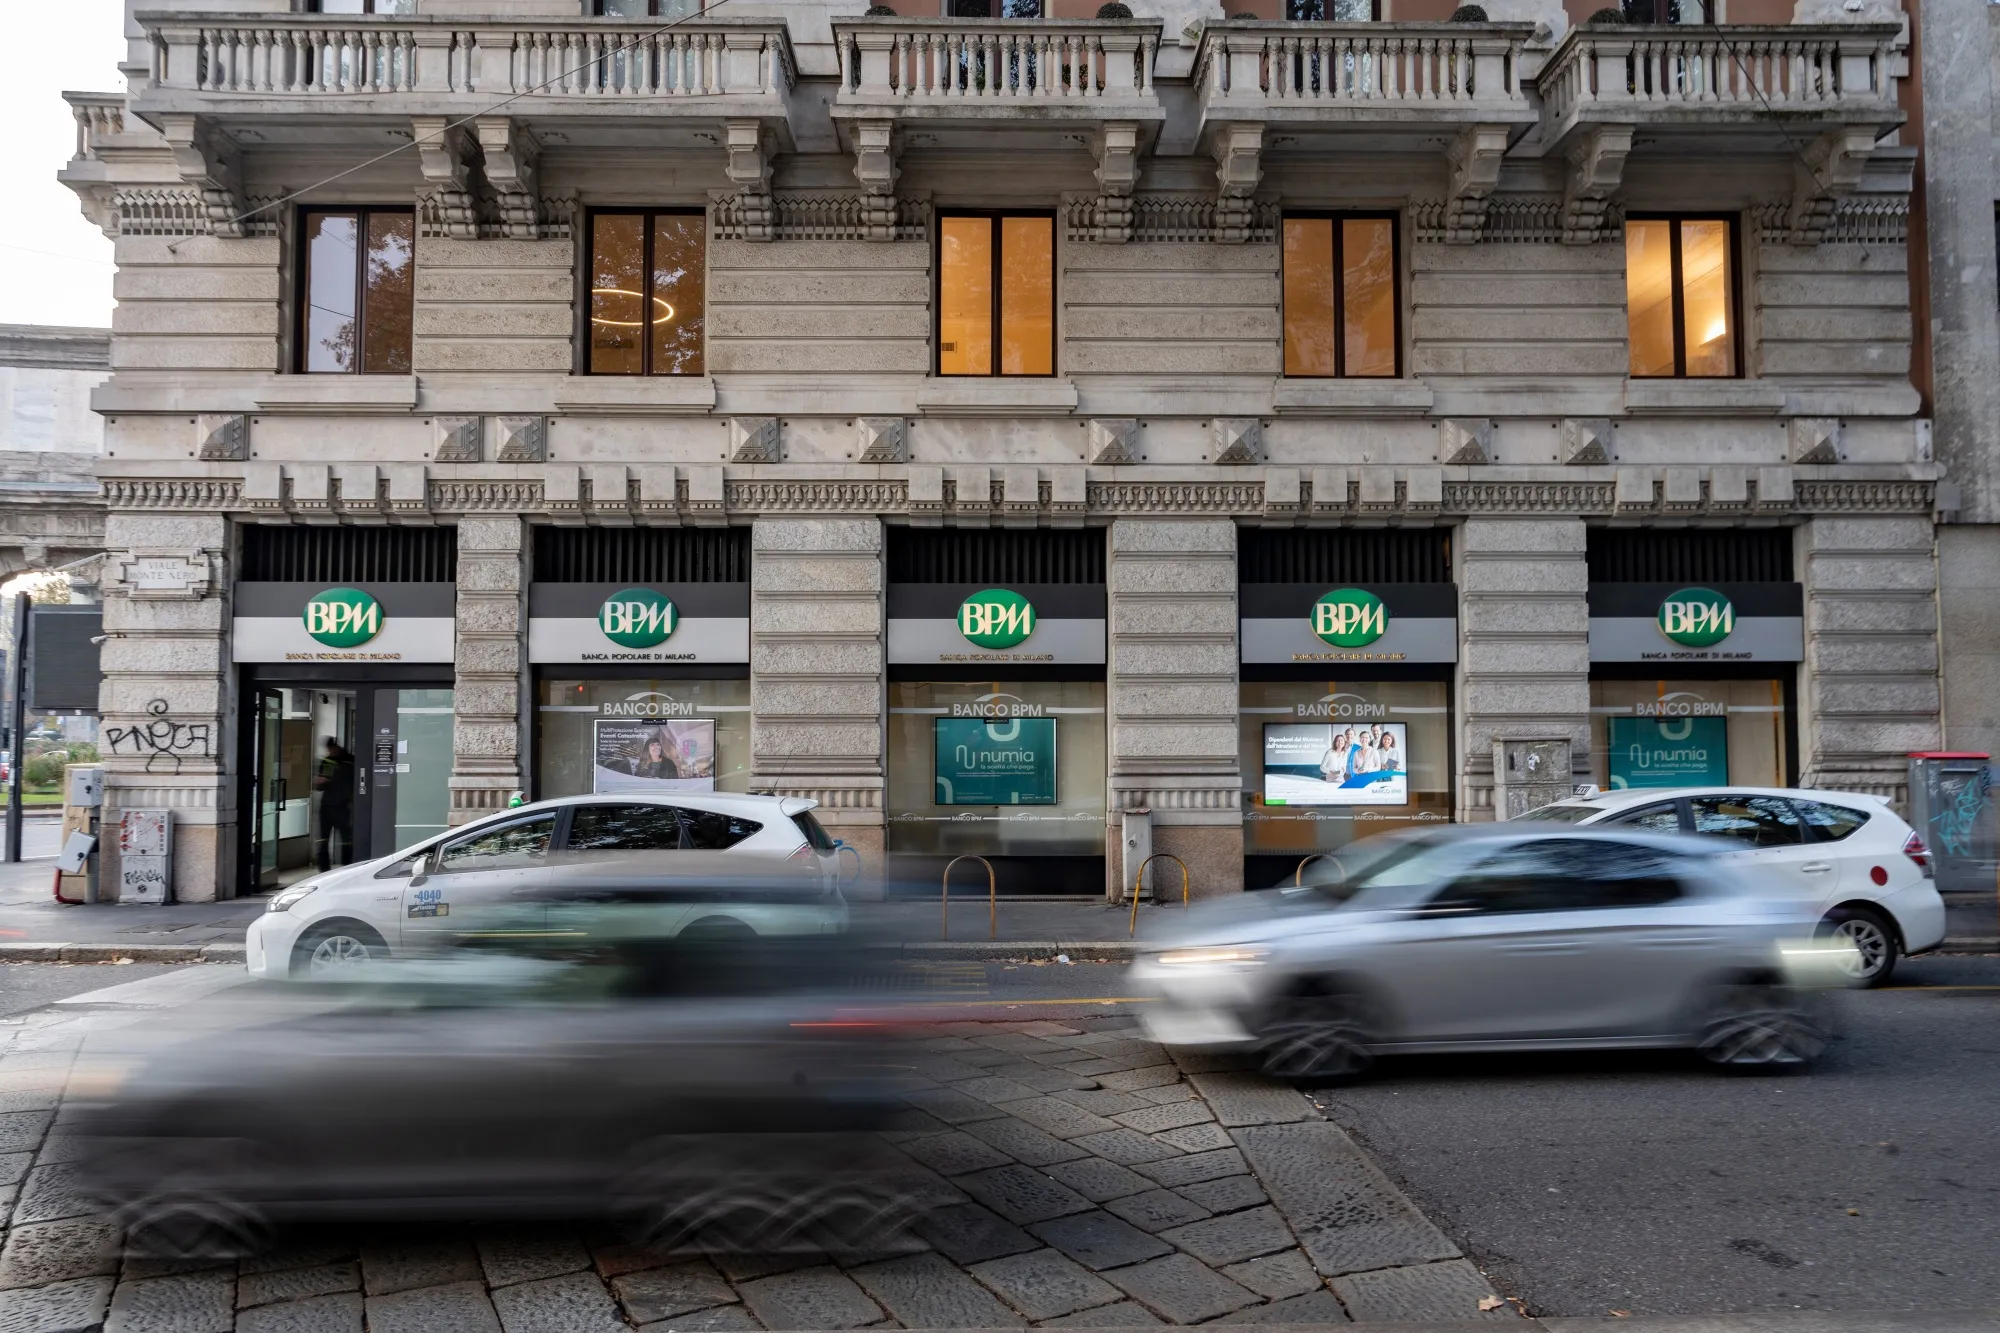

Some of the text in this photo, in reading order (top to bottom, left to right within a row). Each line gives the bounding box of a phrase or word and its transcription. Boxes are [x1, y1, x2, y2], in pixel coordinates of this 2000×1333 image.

[148, 561, 178, 570] VIALE
[129, 571, 196, 580] MONTE NERO
[307, 602, 377, 634] BPM
[604, 601, 672, 634] BPM
[963, 603, 1031, 635] BPM
[1316, 603, 1384, 635] BPM
[1664, 601, 1732, 634] BPM
[1641, 652, 1753, 660] BANCA POPOLARE DI MILANO
[603, 702, 693, 715] BANCO BPM
[953, 703, 1042, 717] BANCO BPM
[1297, 703, 1385, 717] BANCO BPM
[1636, 702, 1724, 716] BANCO BPM
[980, 747, 1034, 762] numia
[1654, 746, 1707, 761] numia
[418, 889, 441, 902] 4040
